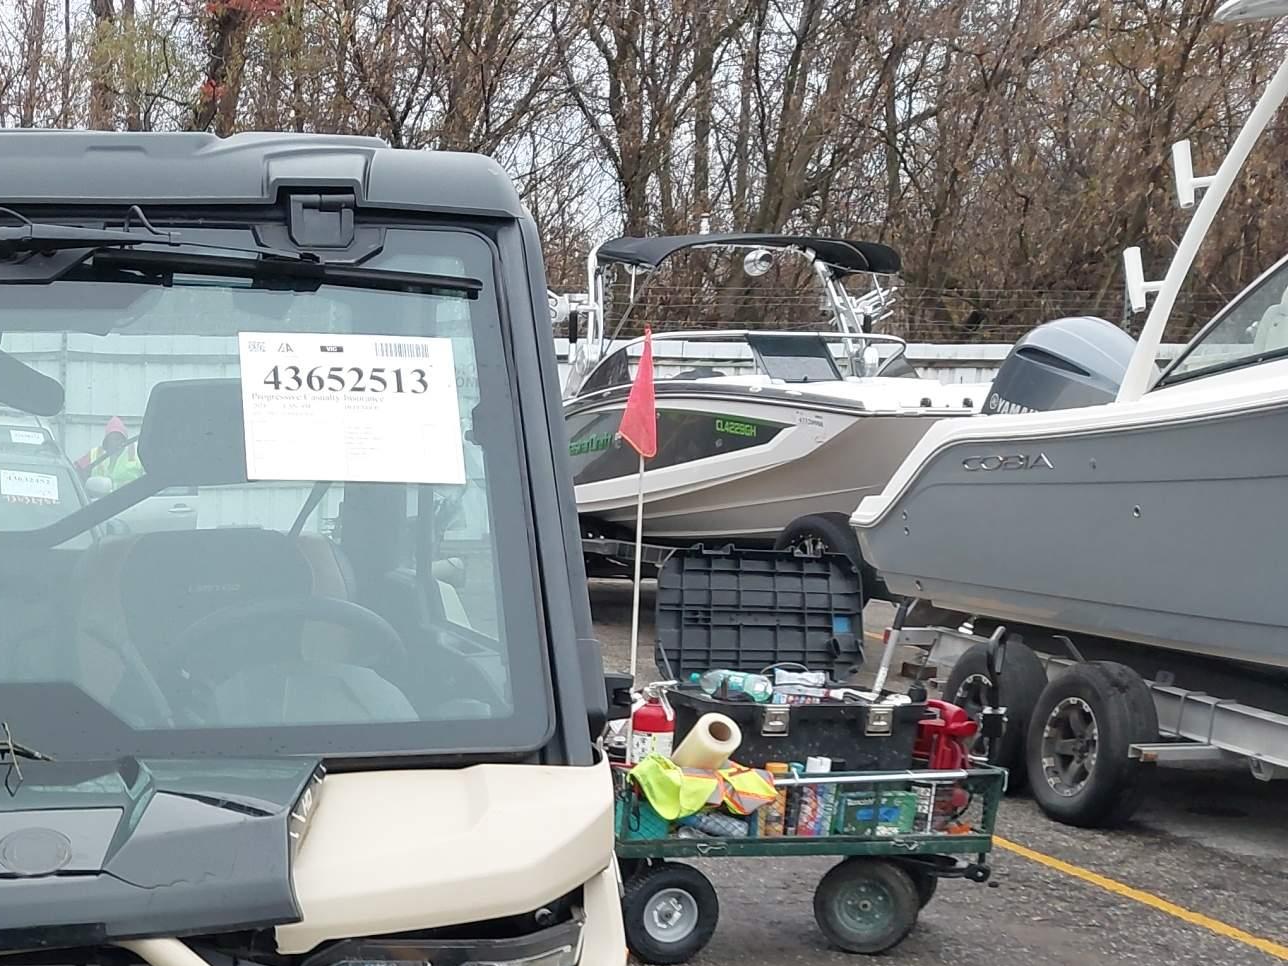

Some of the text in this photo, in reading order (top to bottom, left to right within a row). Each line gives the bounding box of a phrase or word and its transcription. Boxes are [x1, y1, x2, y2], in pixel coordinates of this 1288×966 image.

[263, 364, 429, 394] 43652513
[251, 392, 302, 403] Progressive
[962, 452, 1055, 472] COBIA
